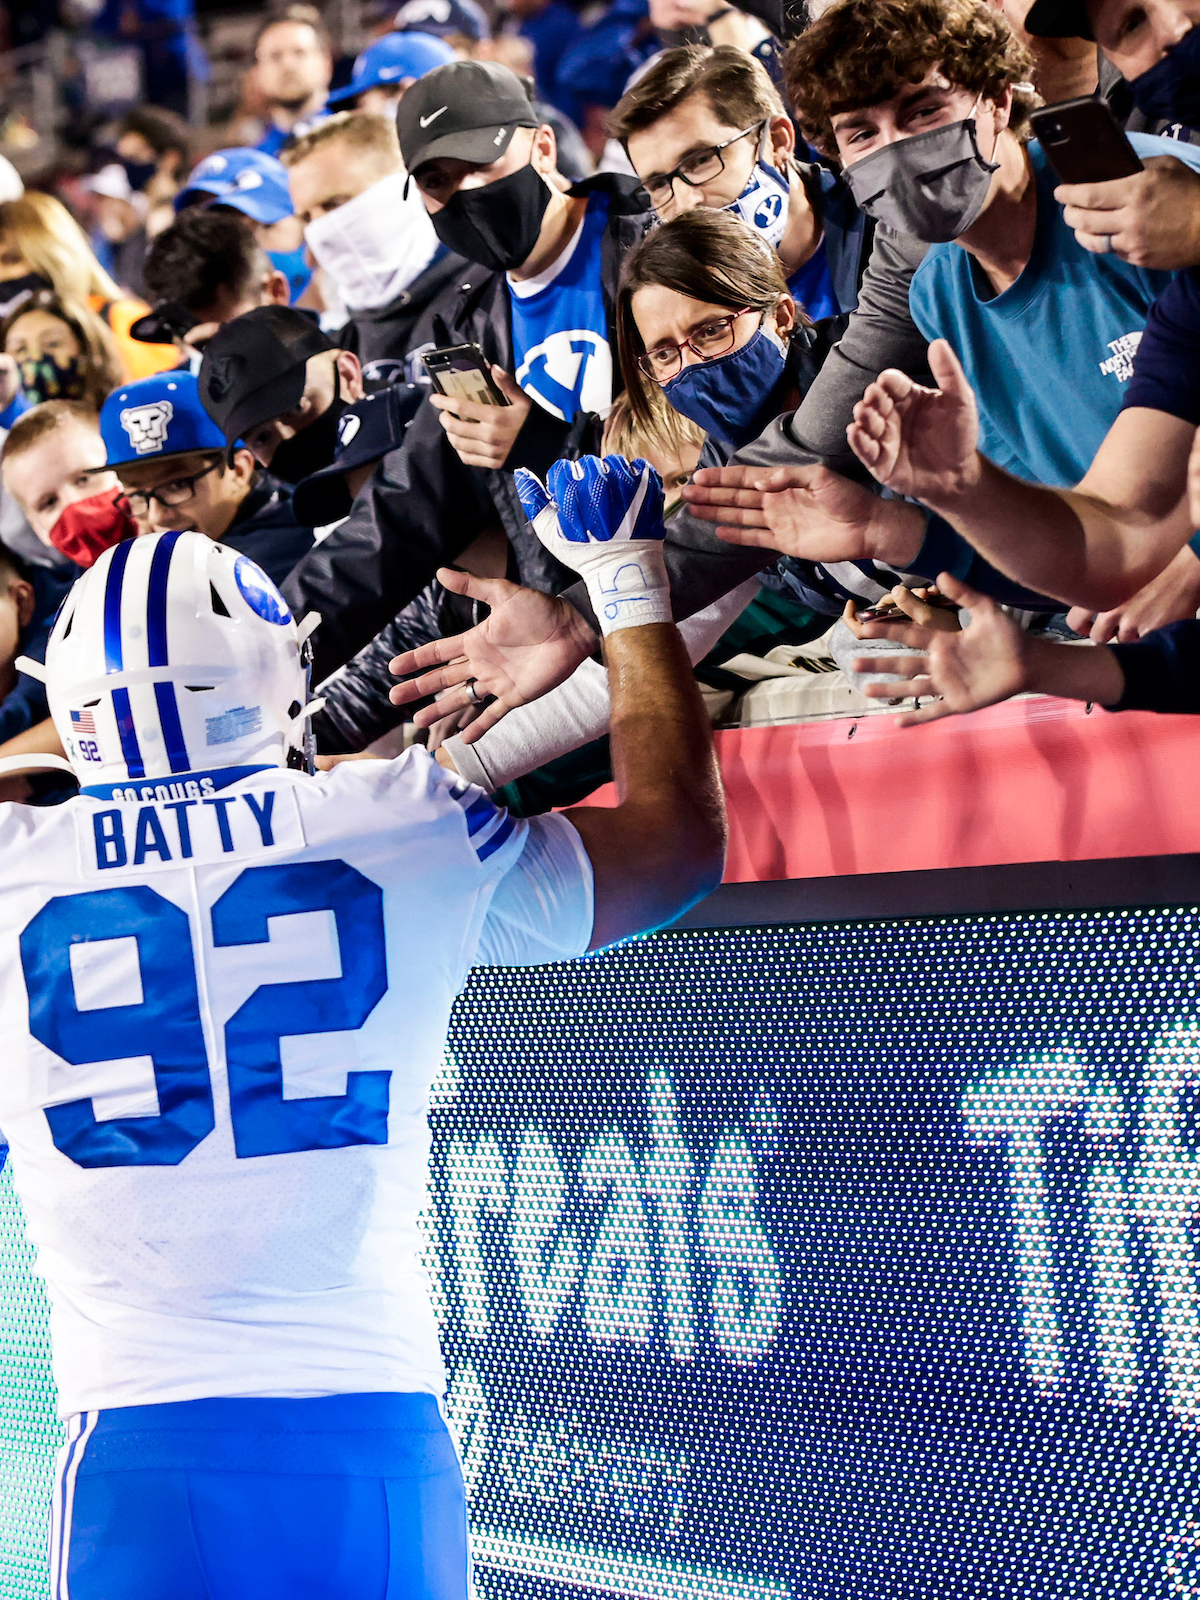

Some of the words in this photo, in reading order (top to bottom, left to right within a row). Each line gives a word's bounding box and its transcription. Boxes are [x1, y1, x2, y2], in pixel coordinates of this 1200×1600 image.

[79, 740, 102, 762] 92
[93, 790, 276, 869] BATTY
[19, 859, 392, 1169] 92
